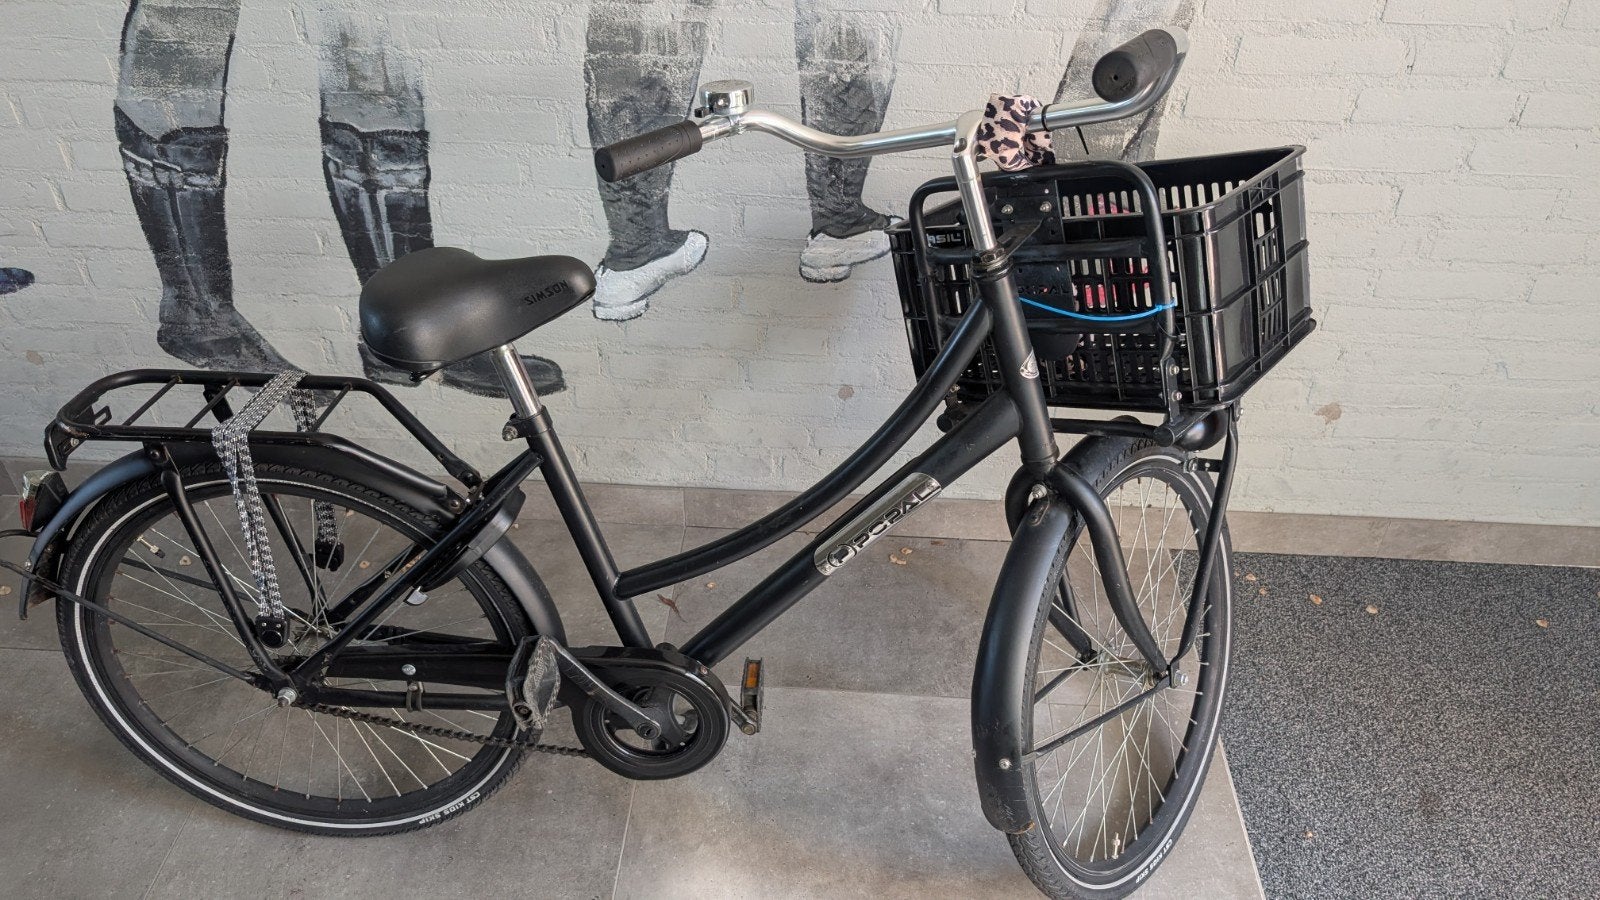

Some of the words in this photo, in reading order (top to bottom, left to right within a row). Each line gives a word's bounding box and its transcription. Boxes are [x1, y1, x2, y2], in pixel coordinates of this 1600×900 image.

[926, 232, 962, 244] ASIL
[523, 279, 569, 306] SIMSON
[852, 484, 941, 550] POPAL
[466, 790, 481, 804] CST
[443, 802, 465, 816] KIDS
[418, 811, 442, 825] SKIP
